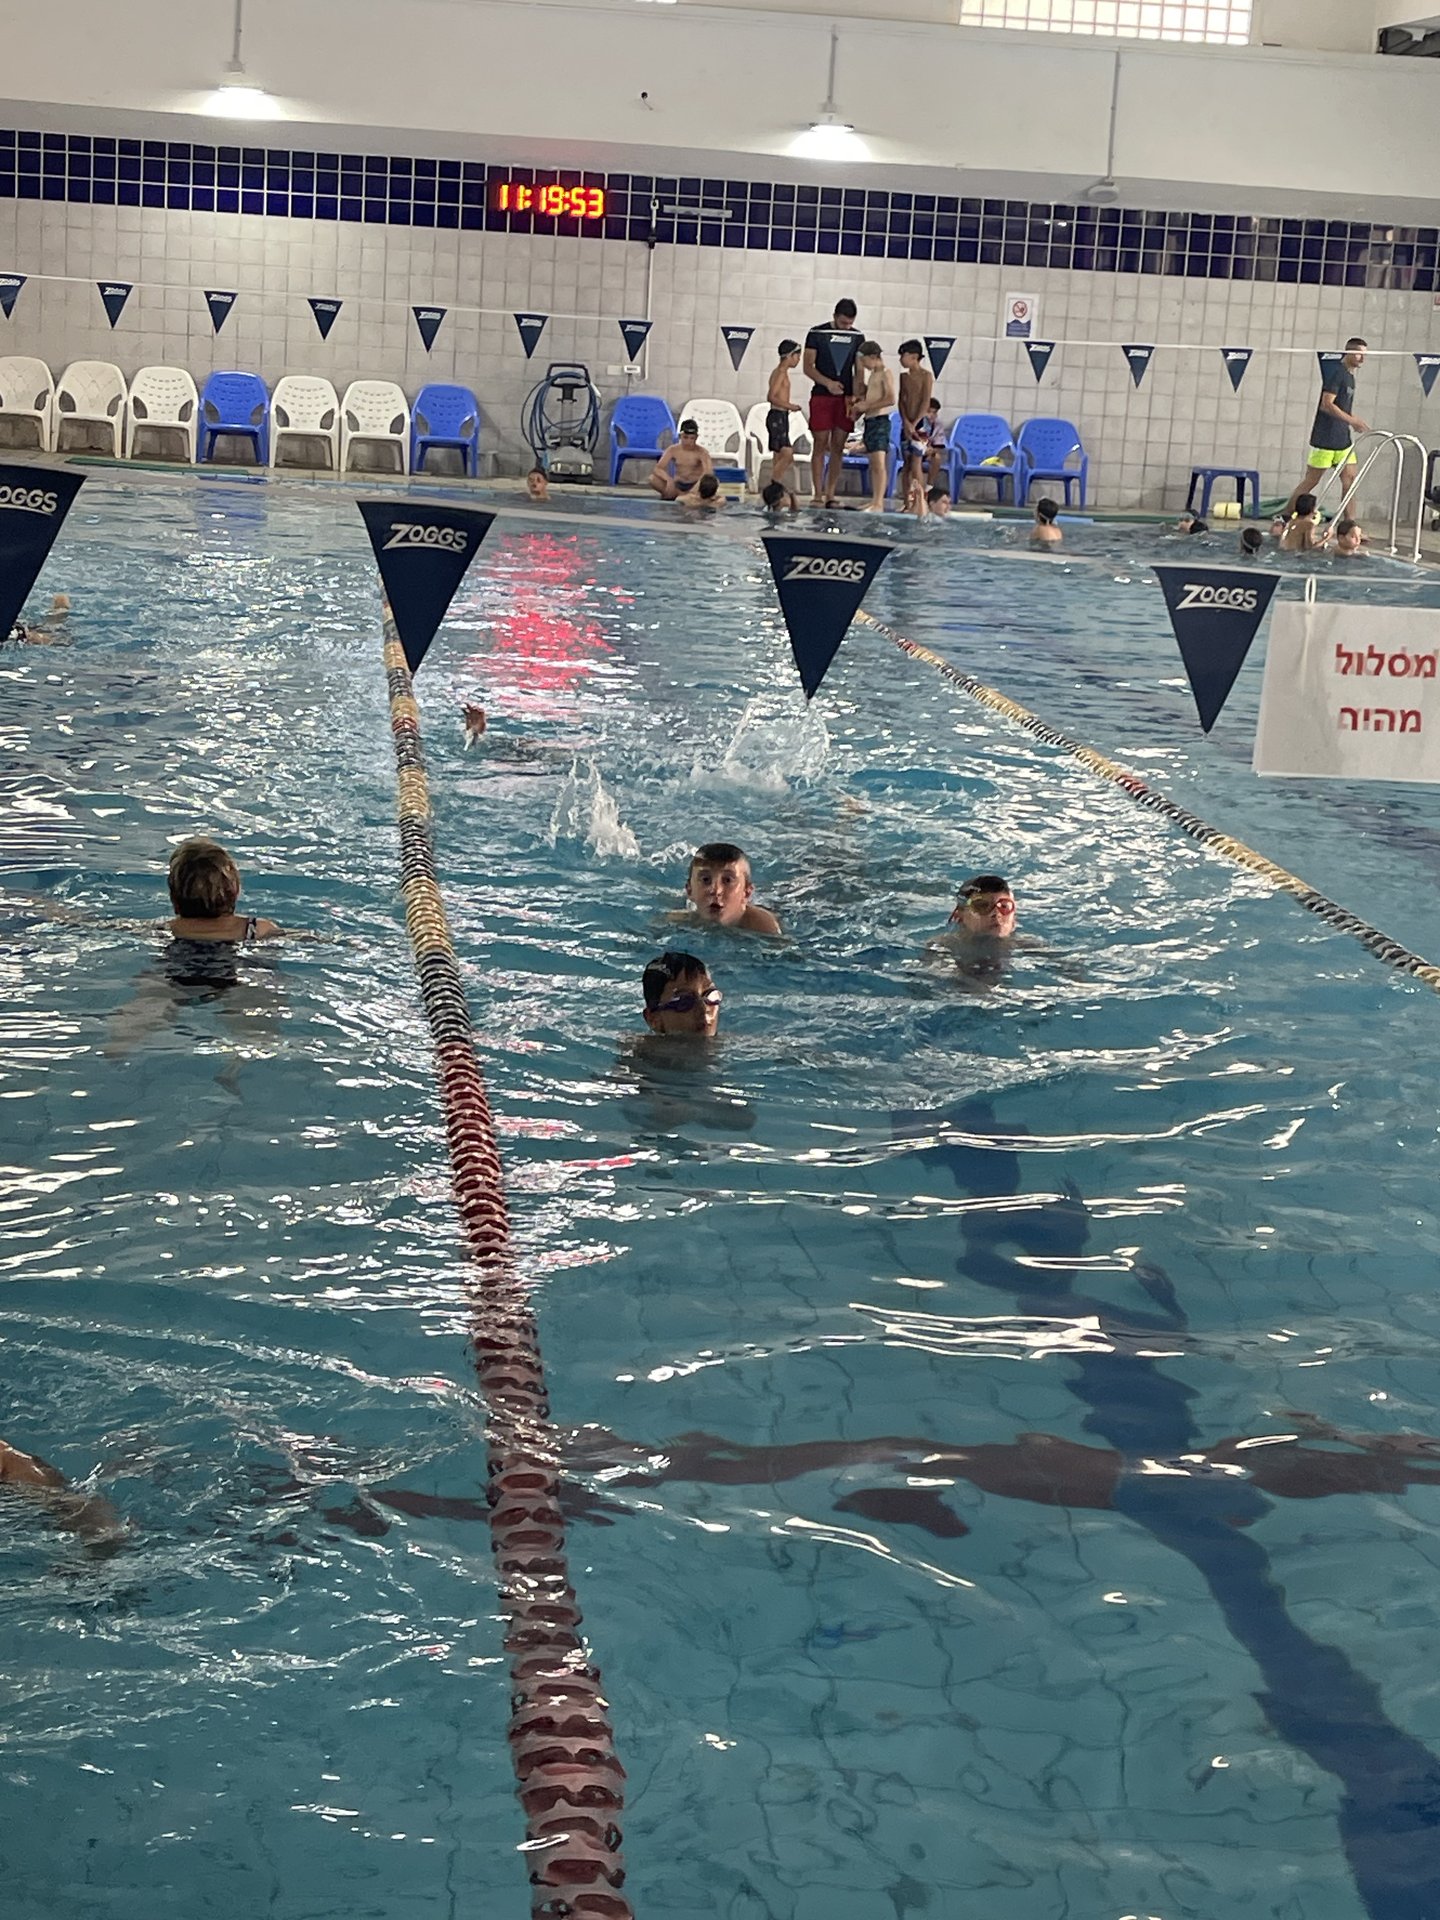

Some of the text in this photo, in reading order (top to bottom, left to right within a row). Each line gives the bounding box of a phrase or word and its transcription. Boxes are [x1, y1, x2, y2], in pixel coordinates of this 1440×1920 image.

[500, 184, 605, 219] 11:19:53
[0, 485, 58, 516] OGGS
[382, 523, 468, 553] ZOGGS
[782, 555, 867, 583] ZOGGS
[1175, 583, 1258, 612] ZOGGS
[1335, 643, 1437, 678] מסלול
[1340, 706, 1422, 733] מהיר
